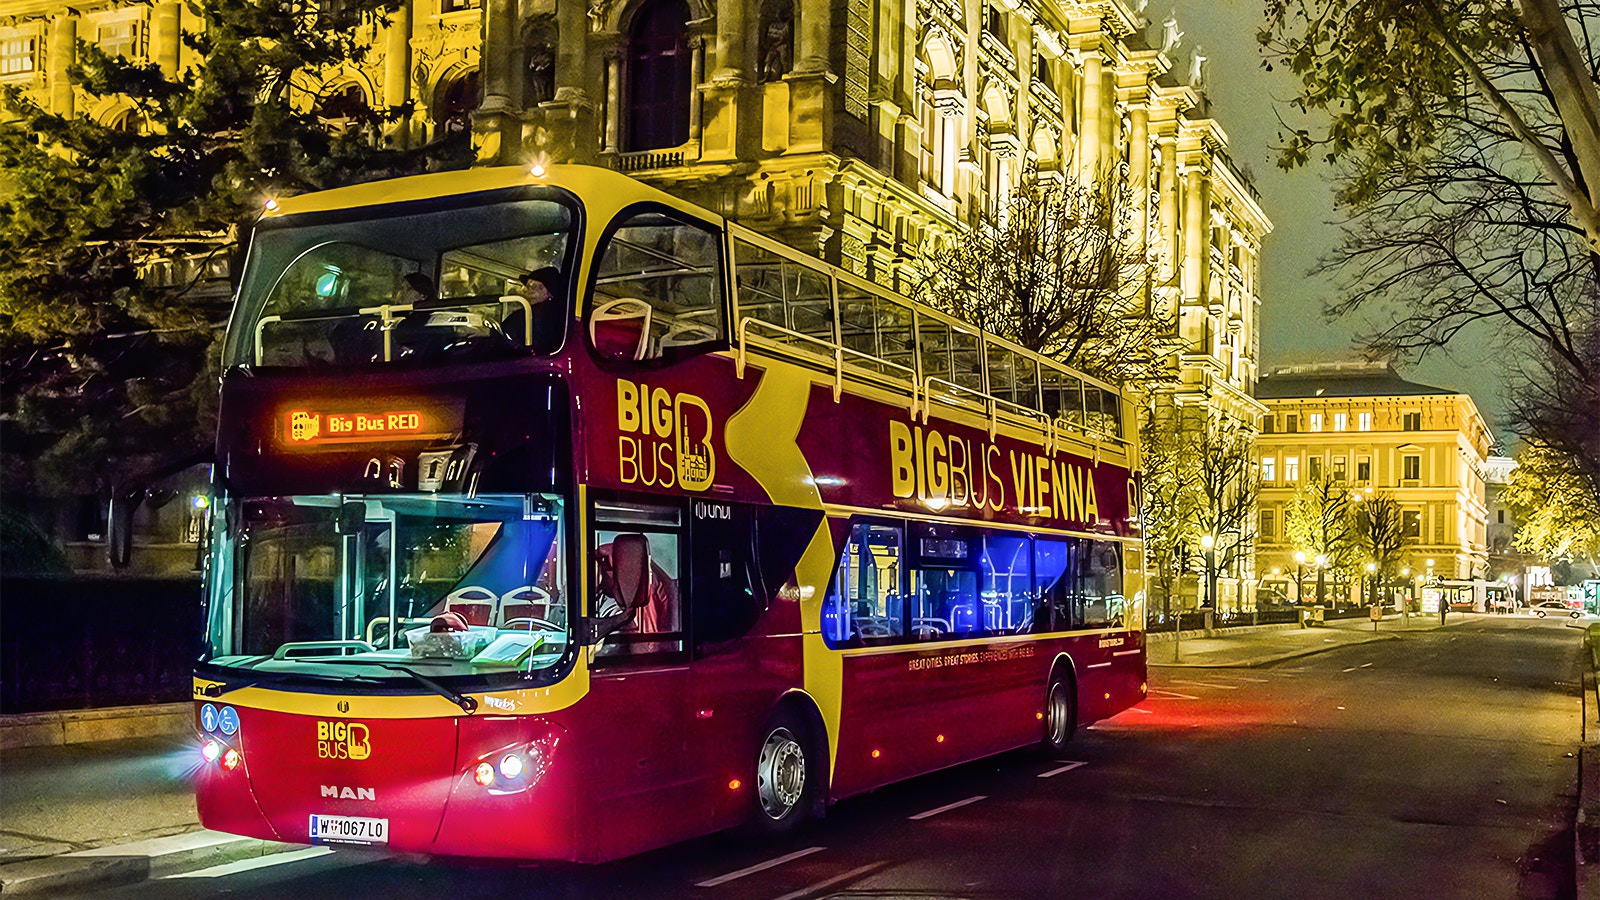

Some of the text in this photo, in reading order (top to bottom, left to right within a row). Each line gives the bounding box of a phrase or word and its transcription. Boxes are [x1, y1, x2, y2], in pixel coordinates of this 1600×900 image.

[617, 378, 673, 438] BIG
[329, 413, 419, 432] Big Bus RED
[619, 435, 676, 489] BUS
[1009, 449, 1099, 524] VIENNA
[317, 720, 347, 742] BIG
[317, 740, 348, 759] BUS
[320, 784, 376, 801] MAN
[338, 820, 365, 836] 1067
